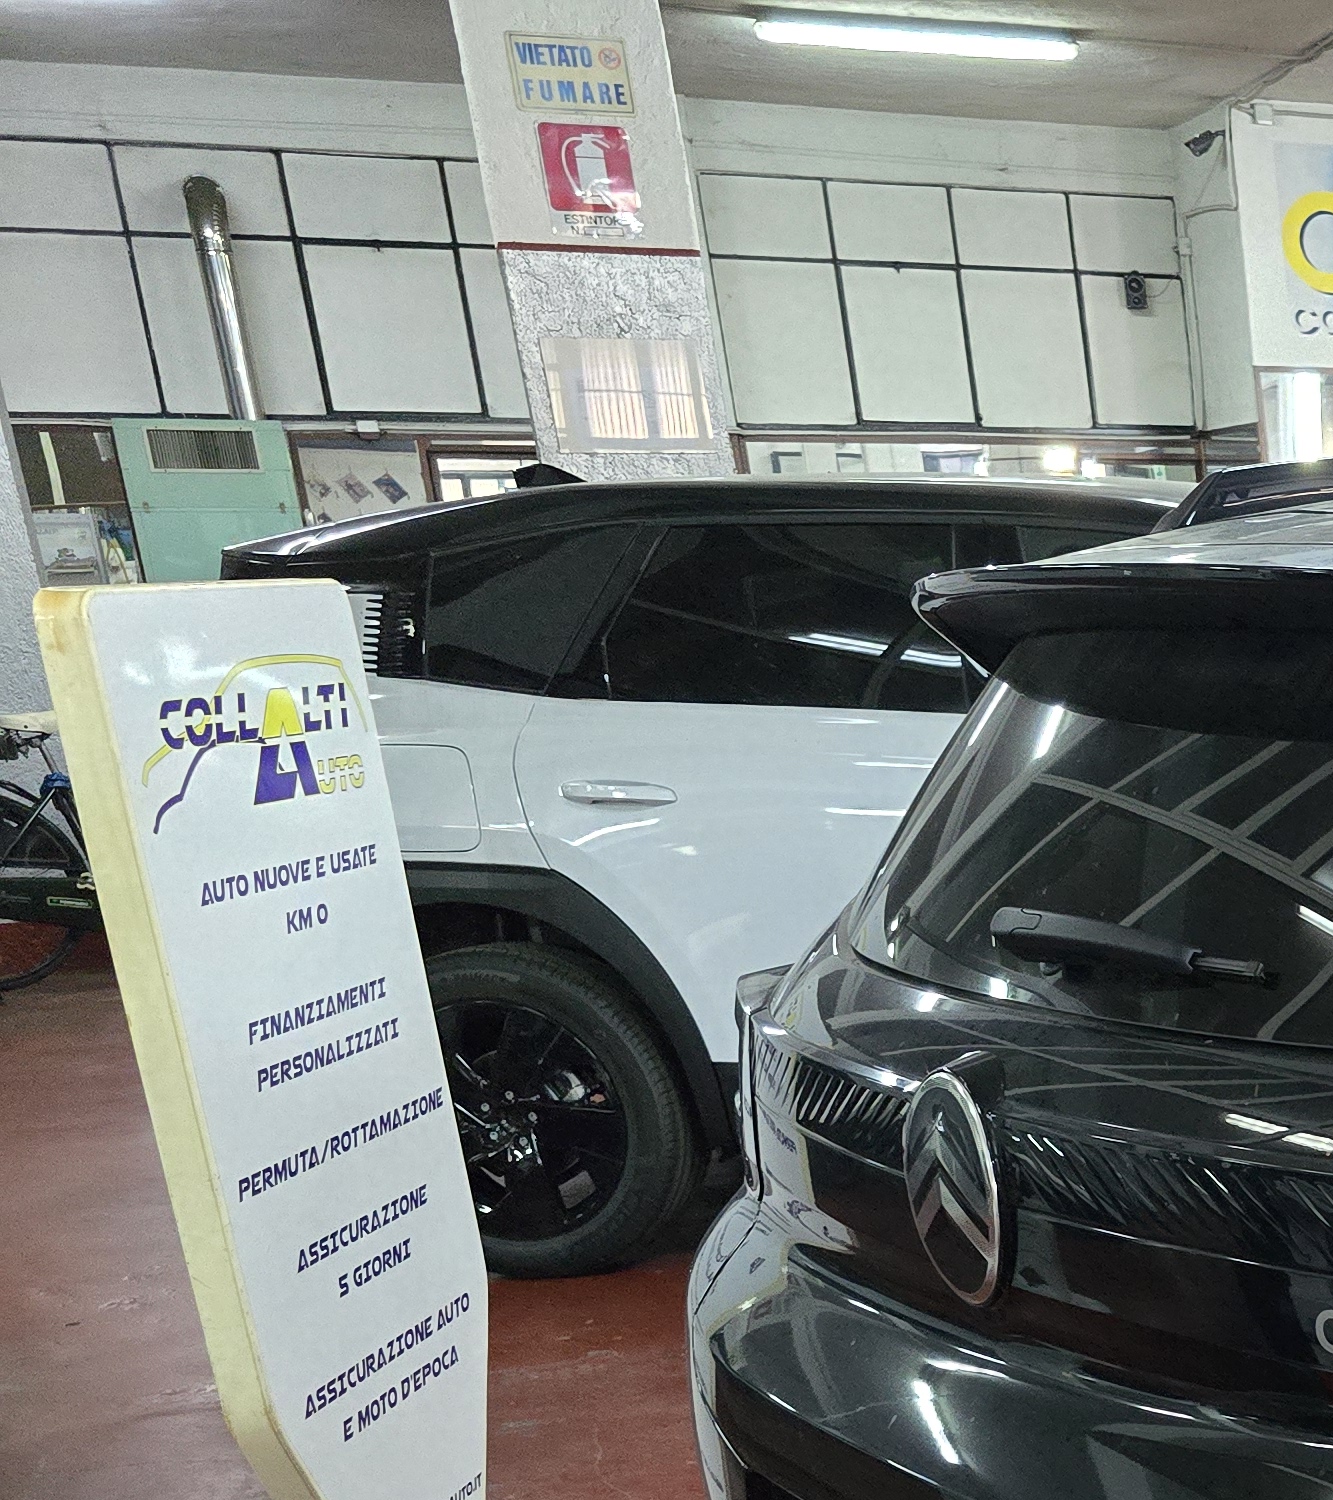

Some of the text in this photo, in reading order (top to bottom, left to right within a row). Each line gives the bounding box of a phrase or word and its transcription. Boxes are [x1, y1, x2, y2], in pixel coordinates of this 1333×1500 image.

[514, 41, 593, 68] VIETATO
[522, 78, 628, 106] FUMARE
[159, 682, 349, 750] COLLALTI
[200, 843, 377, 907] AUTO NUOVE E USATE
[286, 906, 313, 934] KM
[248, 976, 387, 1046] FINANZIAMENTI
[257, 1016, 400, 1093] PERSONALIZZATI
[238, 1086, 444, 1203] PERMUTA/ROTTAMAZIONE
[297, 1183, 428, 1274] ASSICURAZIONE
[338, 1237, 412, 1299] 5 GIORNI
[304, 1292, 470, 1420] ASSICURAZIONE AUTO
[343, 1345, 460, 1443] E MOTO D'EPOCA
